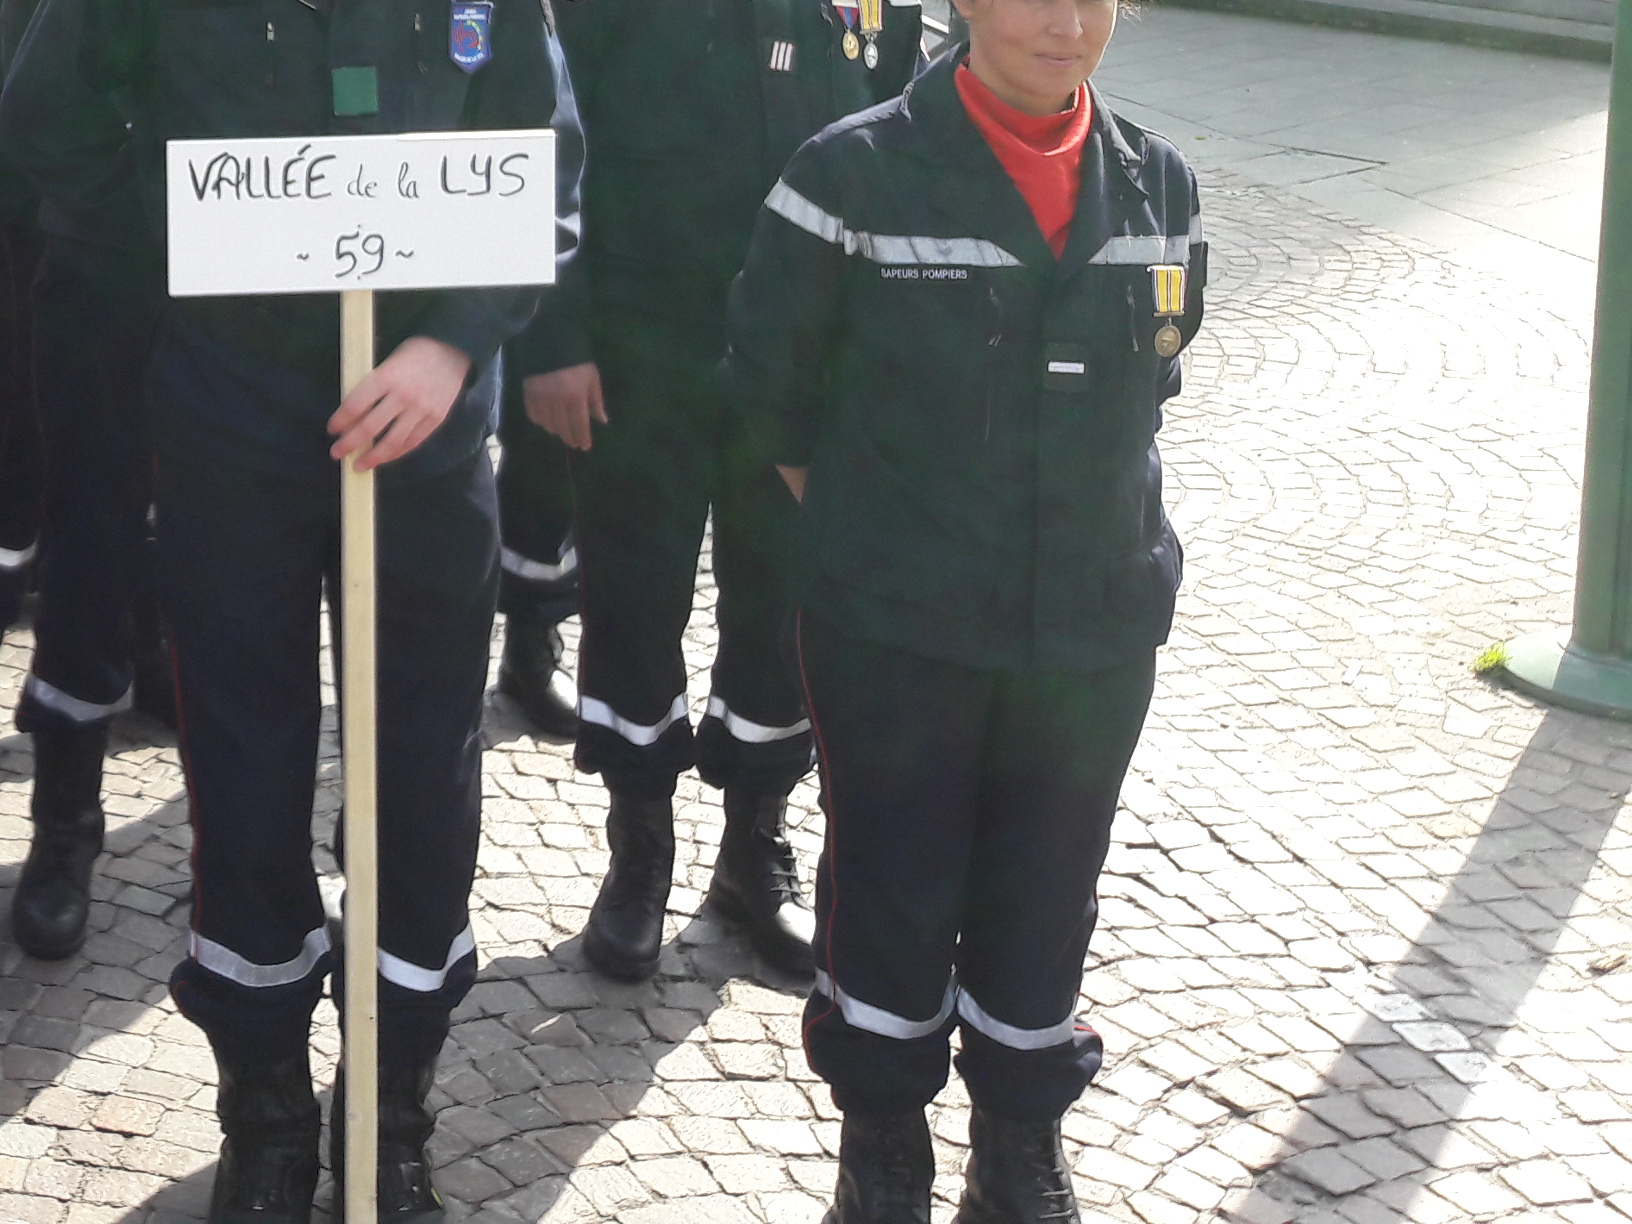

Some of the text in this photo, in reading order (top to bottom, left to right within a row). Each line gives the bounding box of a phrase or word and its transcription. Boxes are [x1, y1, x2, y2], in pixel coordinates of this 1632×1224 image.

[188, 144, 530, 201] VALLÉE de la LYS
[334, 230, 384, 279] 59
[881, 268, 968, 280] SAPEURS POMPIERS
